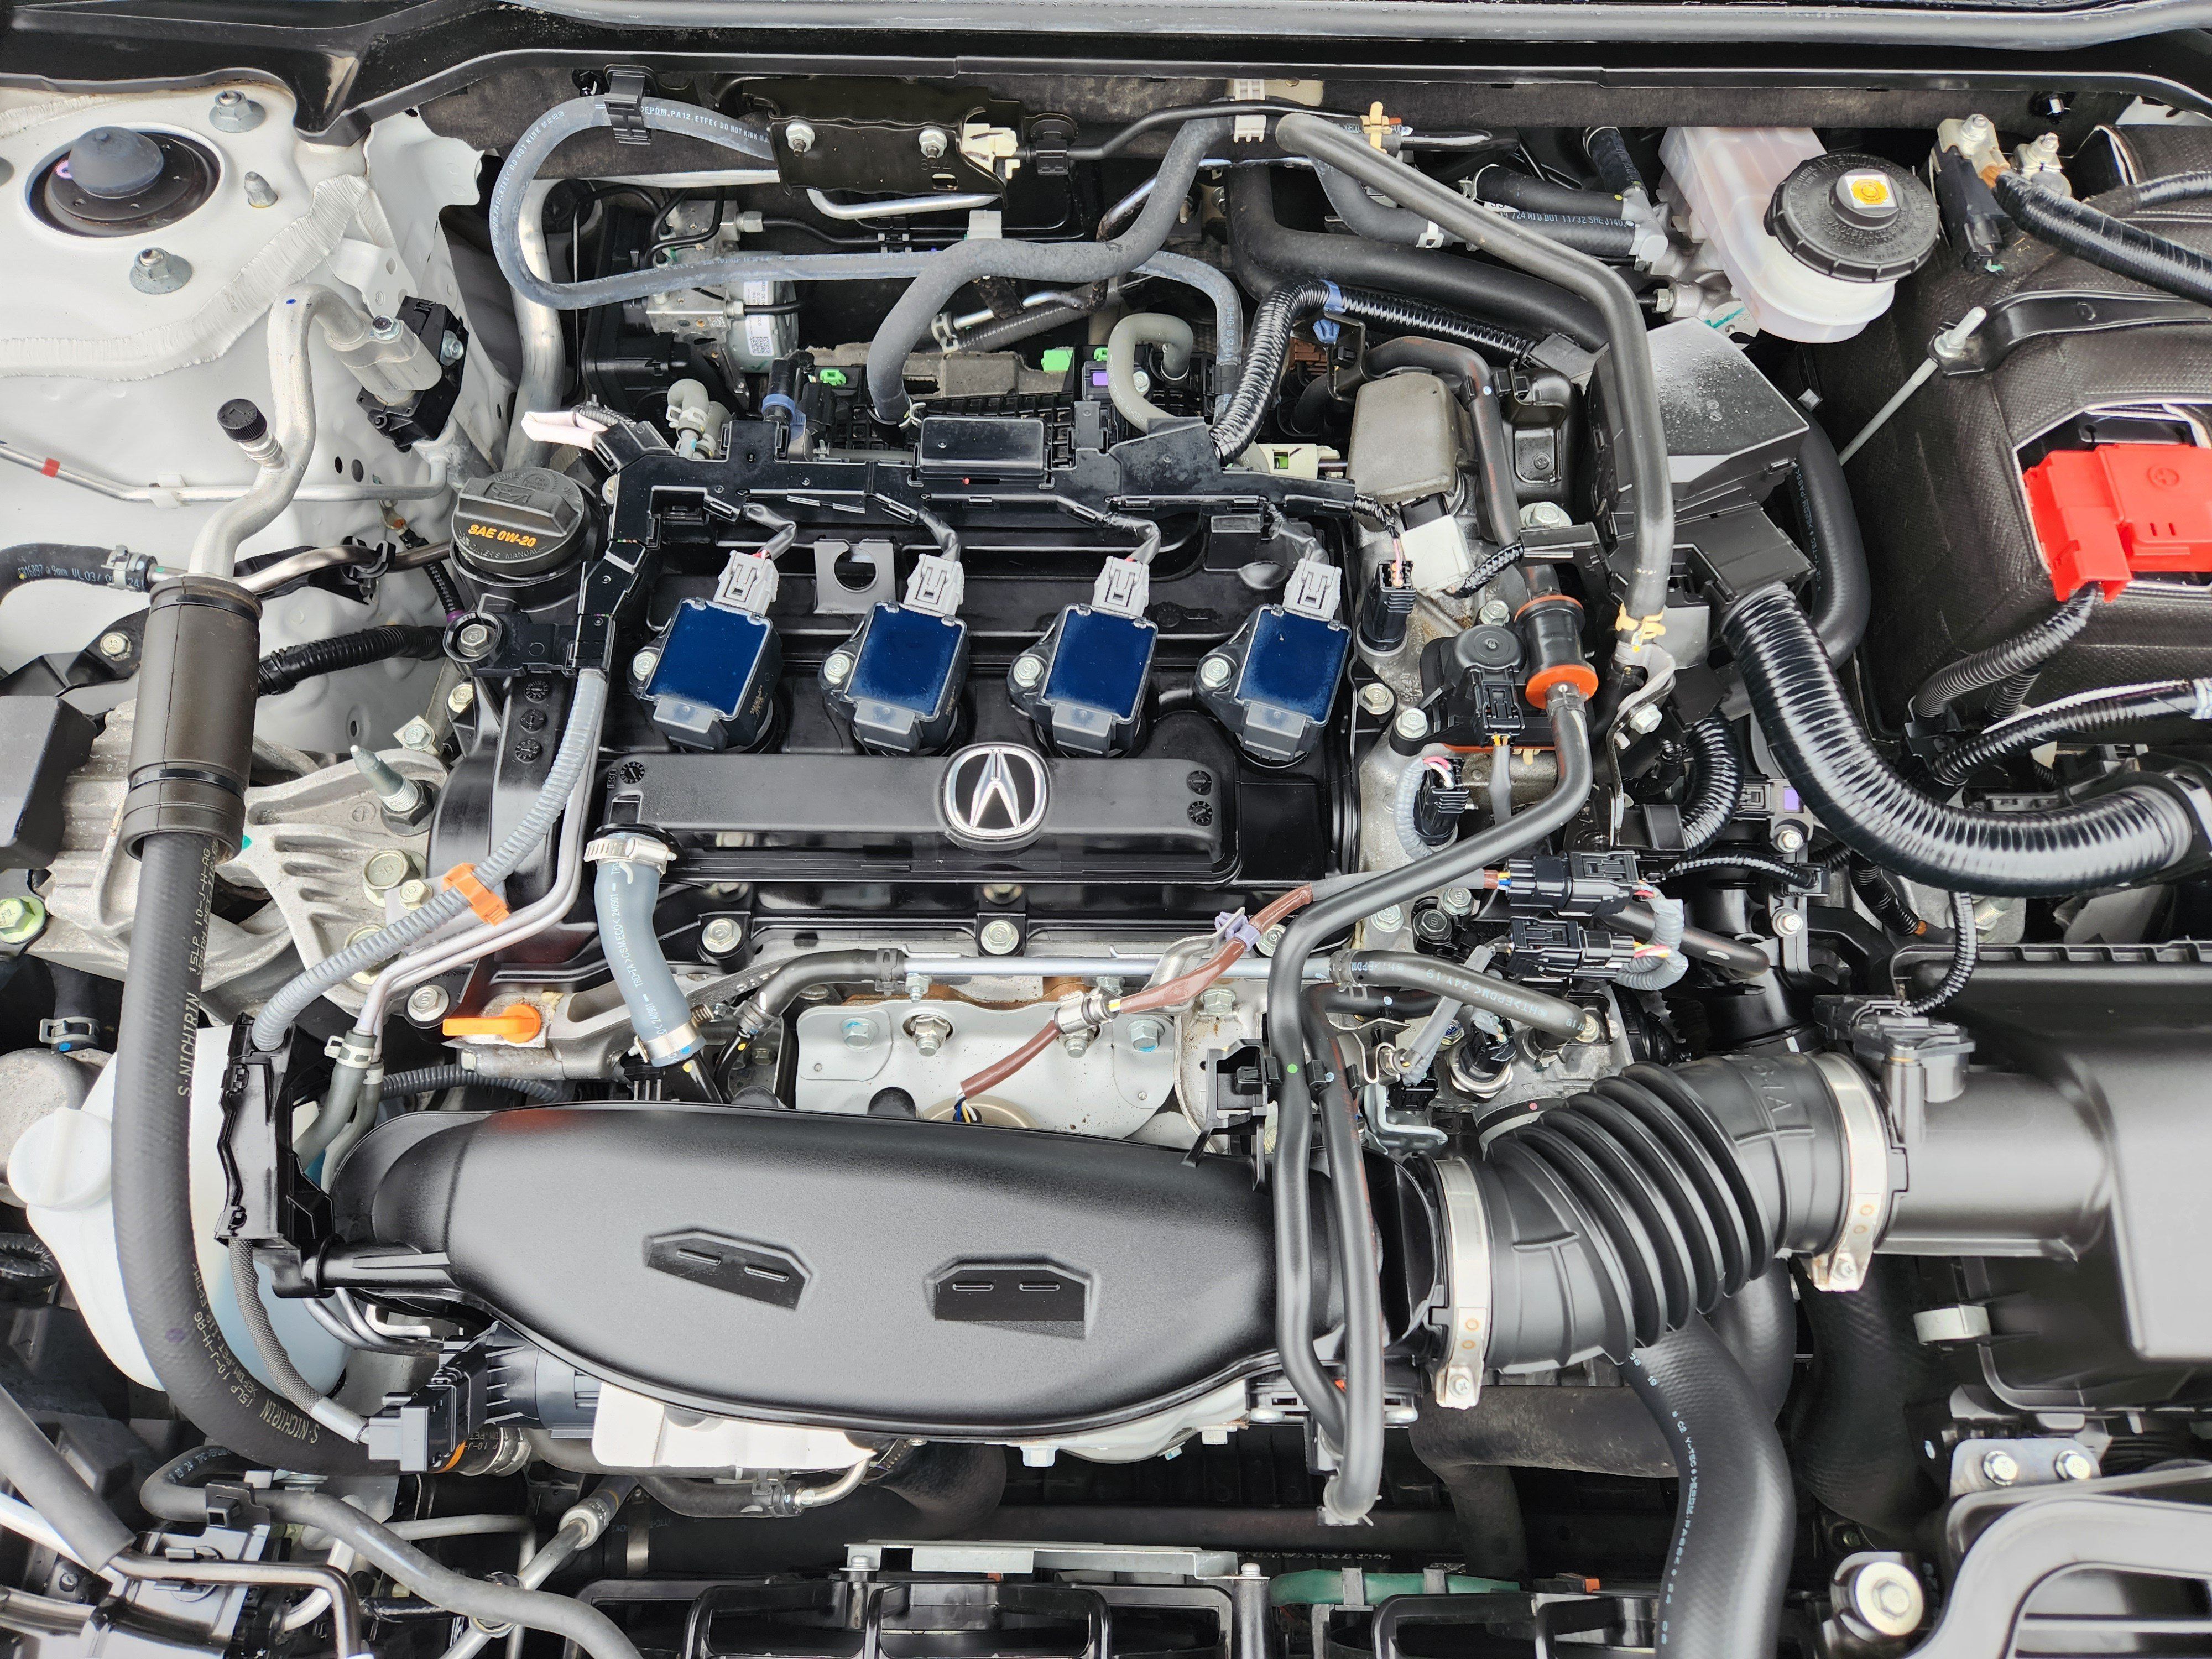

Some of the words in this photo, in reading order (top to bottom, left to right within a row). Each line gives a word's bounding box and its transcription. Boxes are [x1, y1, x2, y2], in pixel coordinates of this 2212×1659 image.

[719, 122, 729, 131] DO
[731, 126, 742, 135] NOT
[744, 129, 758, 140] KINK
[509, 160, 518, 171] DO
[515, 144, 528, 159] NOT
[526, 127, 541, 145] KINK
[1562, 215, 1587, 224] 11/32
[468, 524, 497, 539] SAE
[497, 530, 537, 547] 0W-20
[611, 894, 620, 919] 240901
[645, 1003, 662, 1025] 240901
